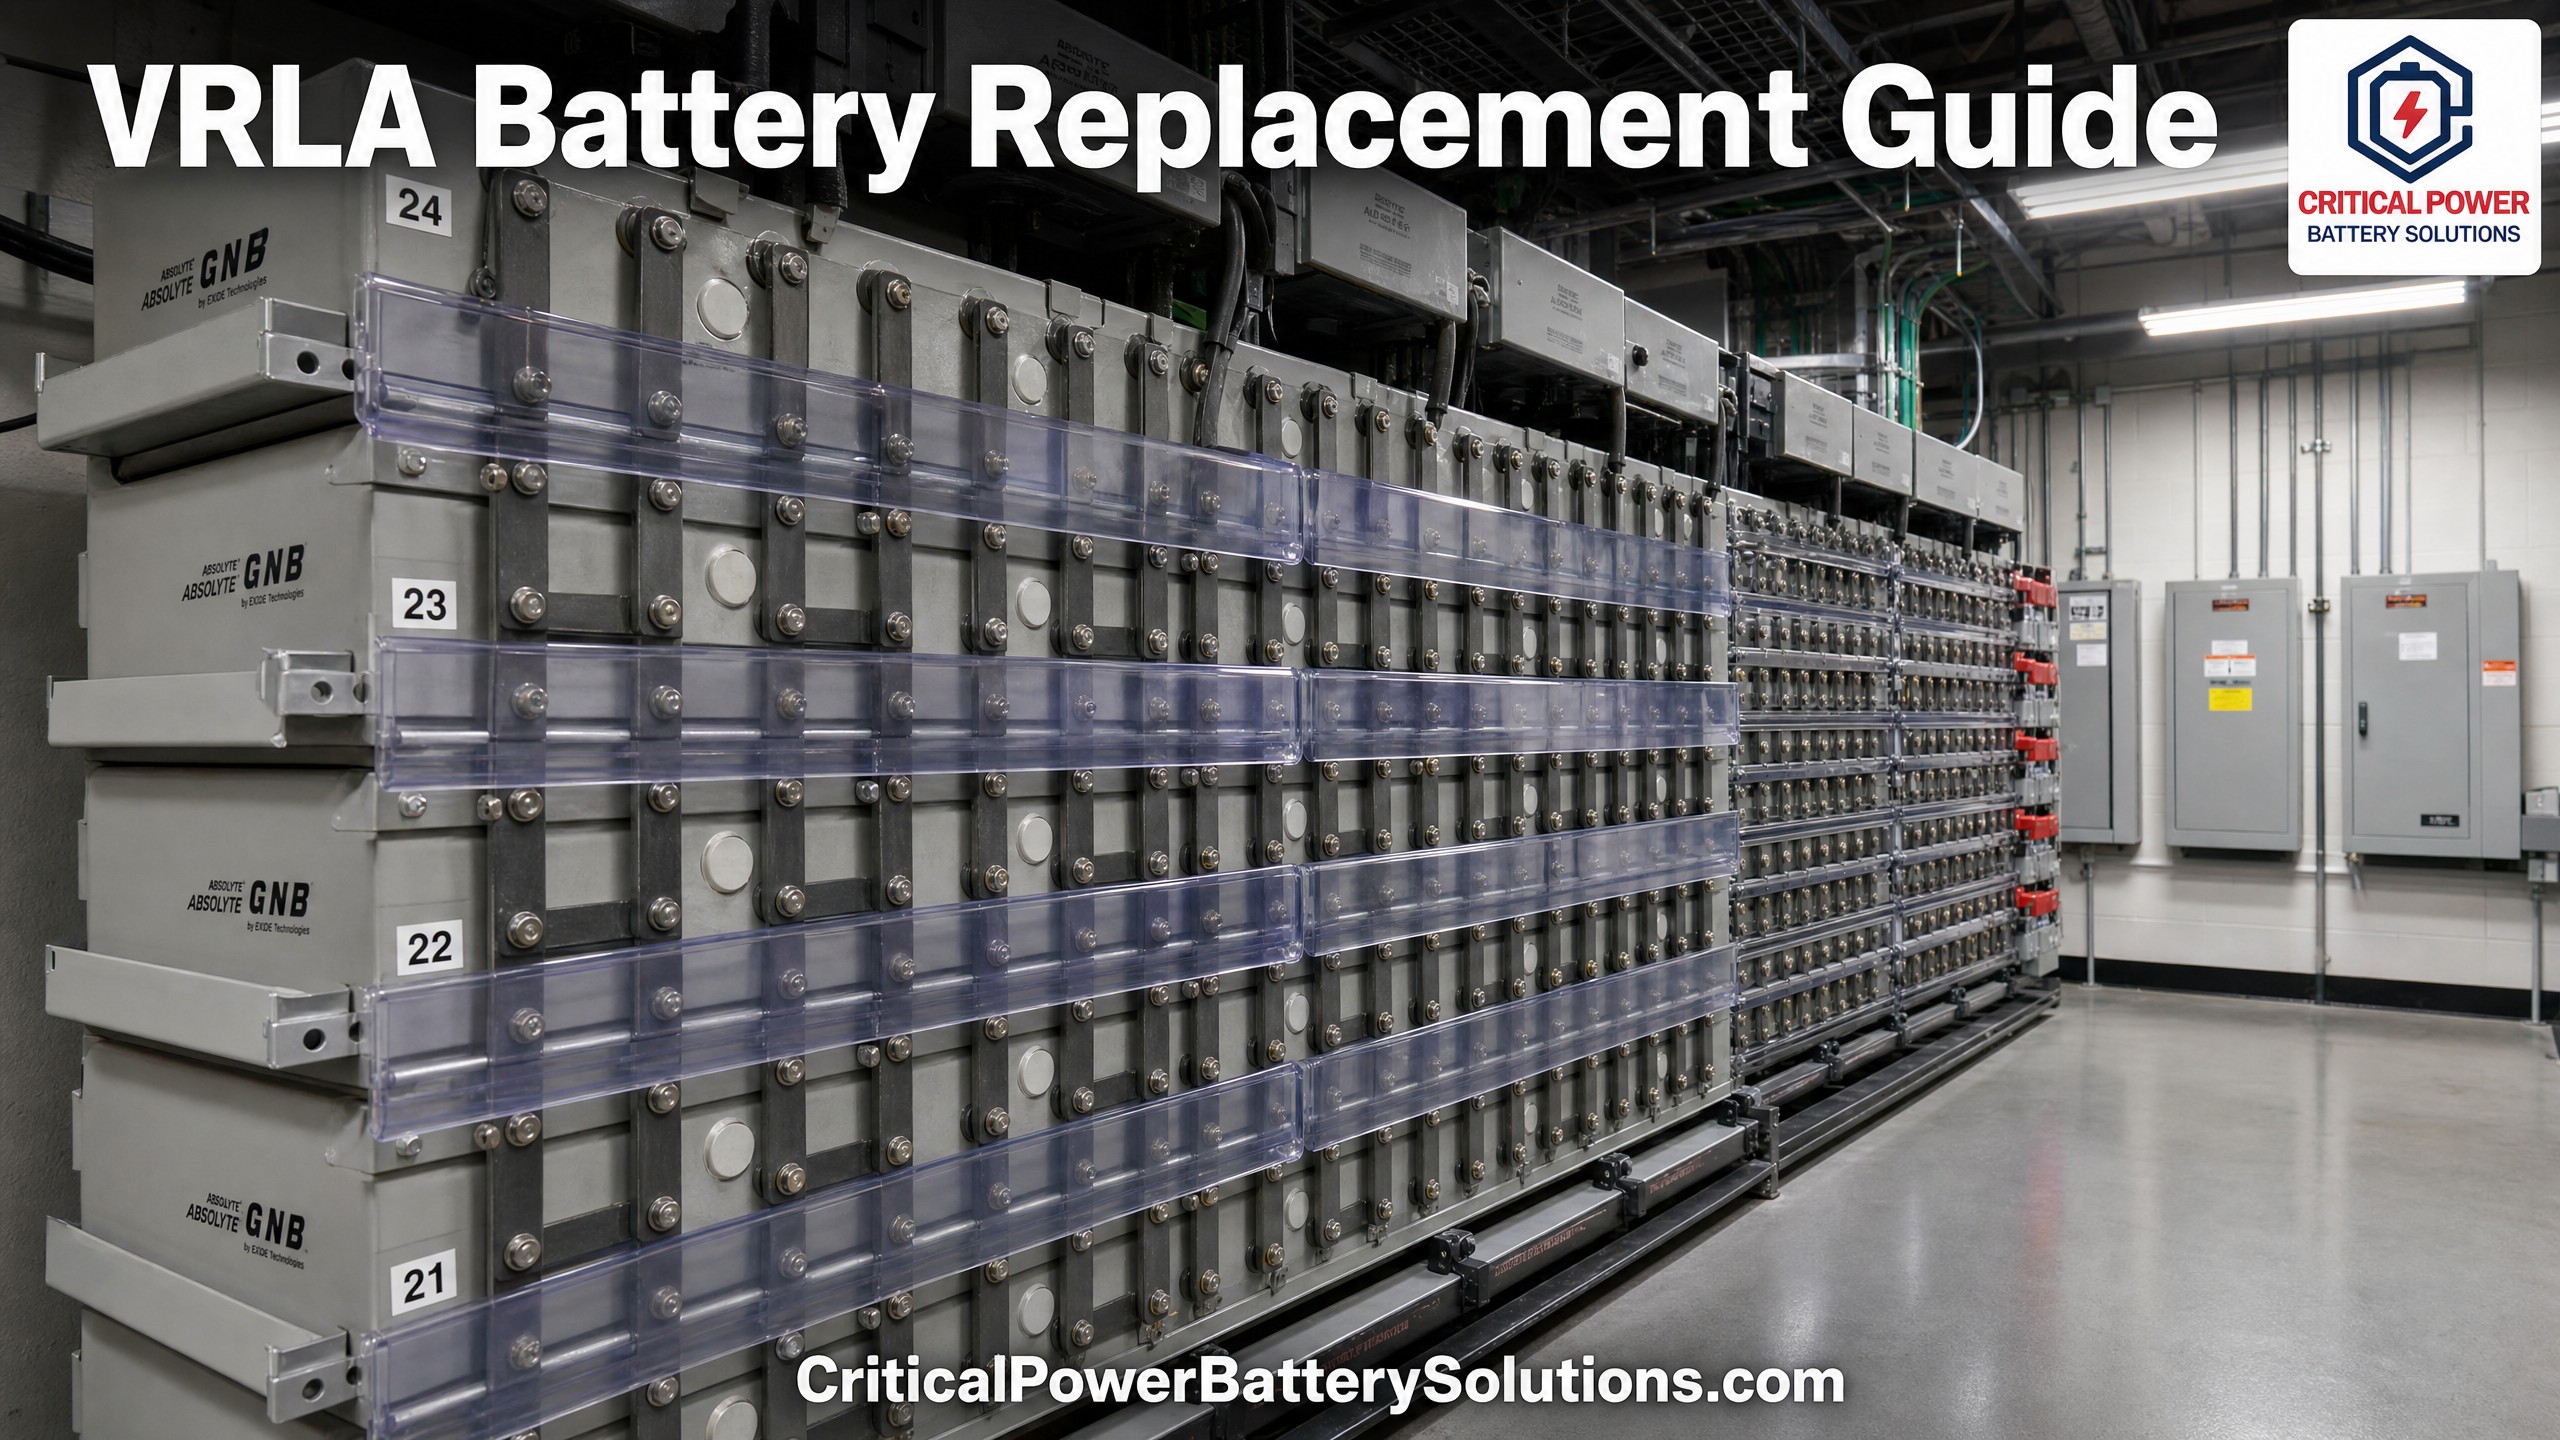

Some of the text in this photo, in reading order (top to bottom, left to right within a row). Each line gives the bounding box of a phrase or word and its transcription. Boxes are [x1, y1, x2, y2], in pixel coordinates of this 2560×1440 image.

[399, 187, 443, 227] 24
[200, 226, 270, 290] GNB
[141, 275, 194, 311] ABSOLYTE
[198, 297, 206, 309] by
[243, 543, 306, 590] GNB
[181, 574, 240, 602] ABSOLYTE
[240, 597, 248, 609] by
[403, 587, 447, 621] 23
[187, 894, 243, 914] ABSOLYTE
[249, 879, 311, 918] GNB
[247, 921, 254, 932] by
[408, 930, 453, 966] 22
[186, 1203, 240, 1234] ABSOLYTE
[245, 1201, 306, 1252] GNB
[243, 1242, 251, 1254] by
[403, 1261, 443, 1305] 21
